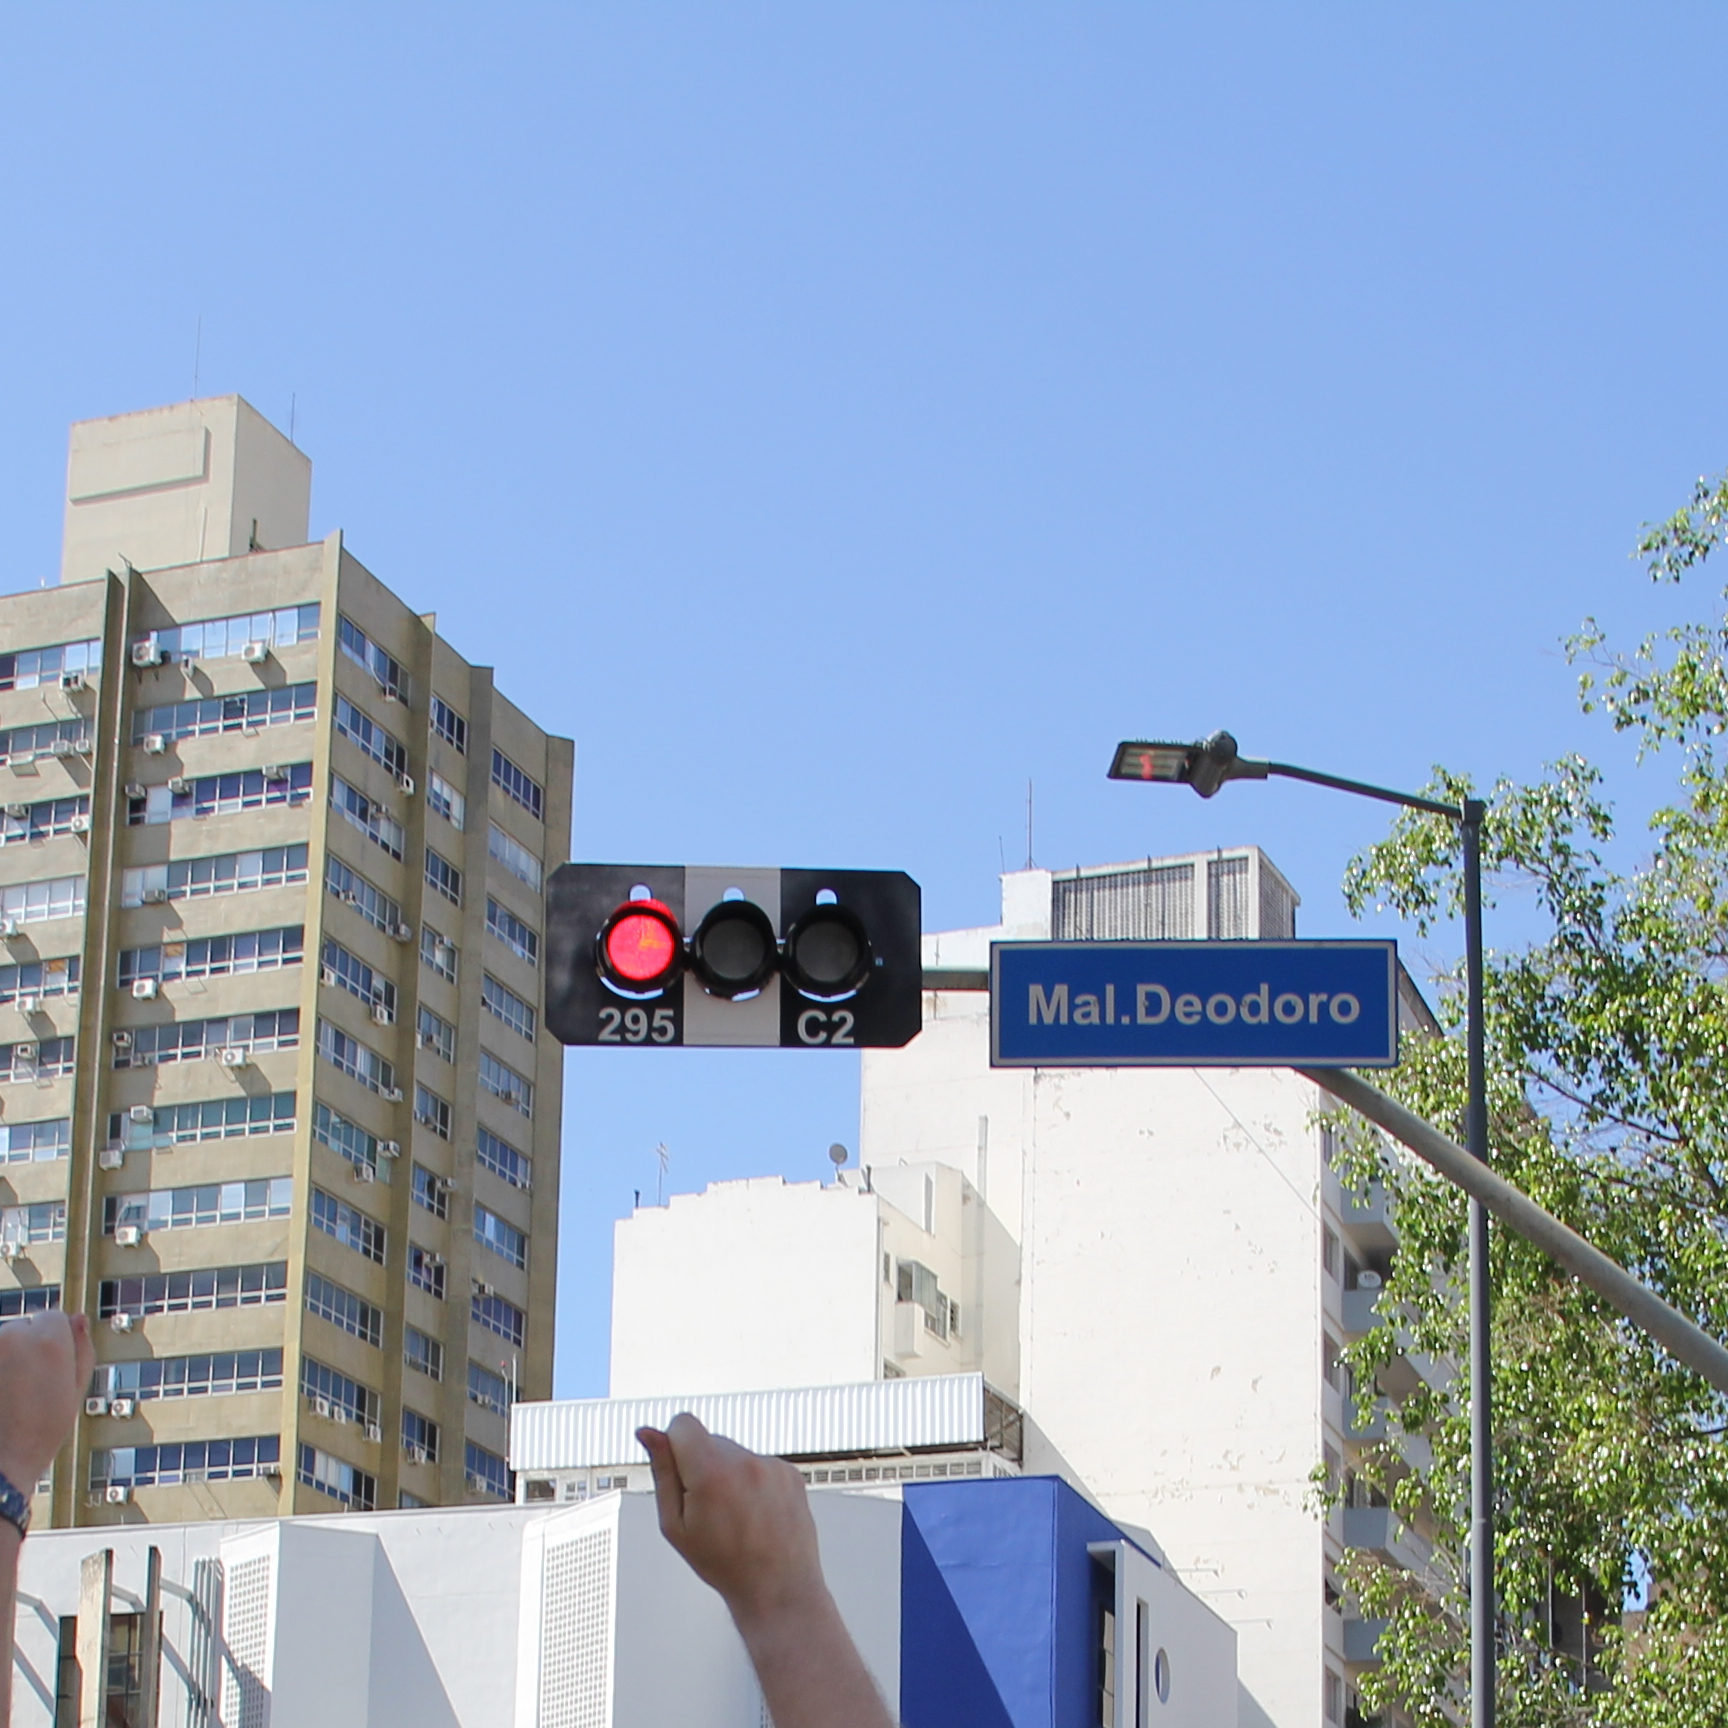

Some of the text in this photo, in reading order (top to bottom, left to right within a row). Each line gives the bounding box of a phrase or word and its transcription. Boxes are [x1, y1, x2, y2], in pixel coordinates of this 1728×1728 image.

[1028, 983, 1360, 1025] Mal.Deodoro
[598, 1007, 855, 1045] 295 C2
